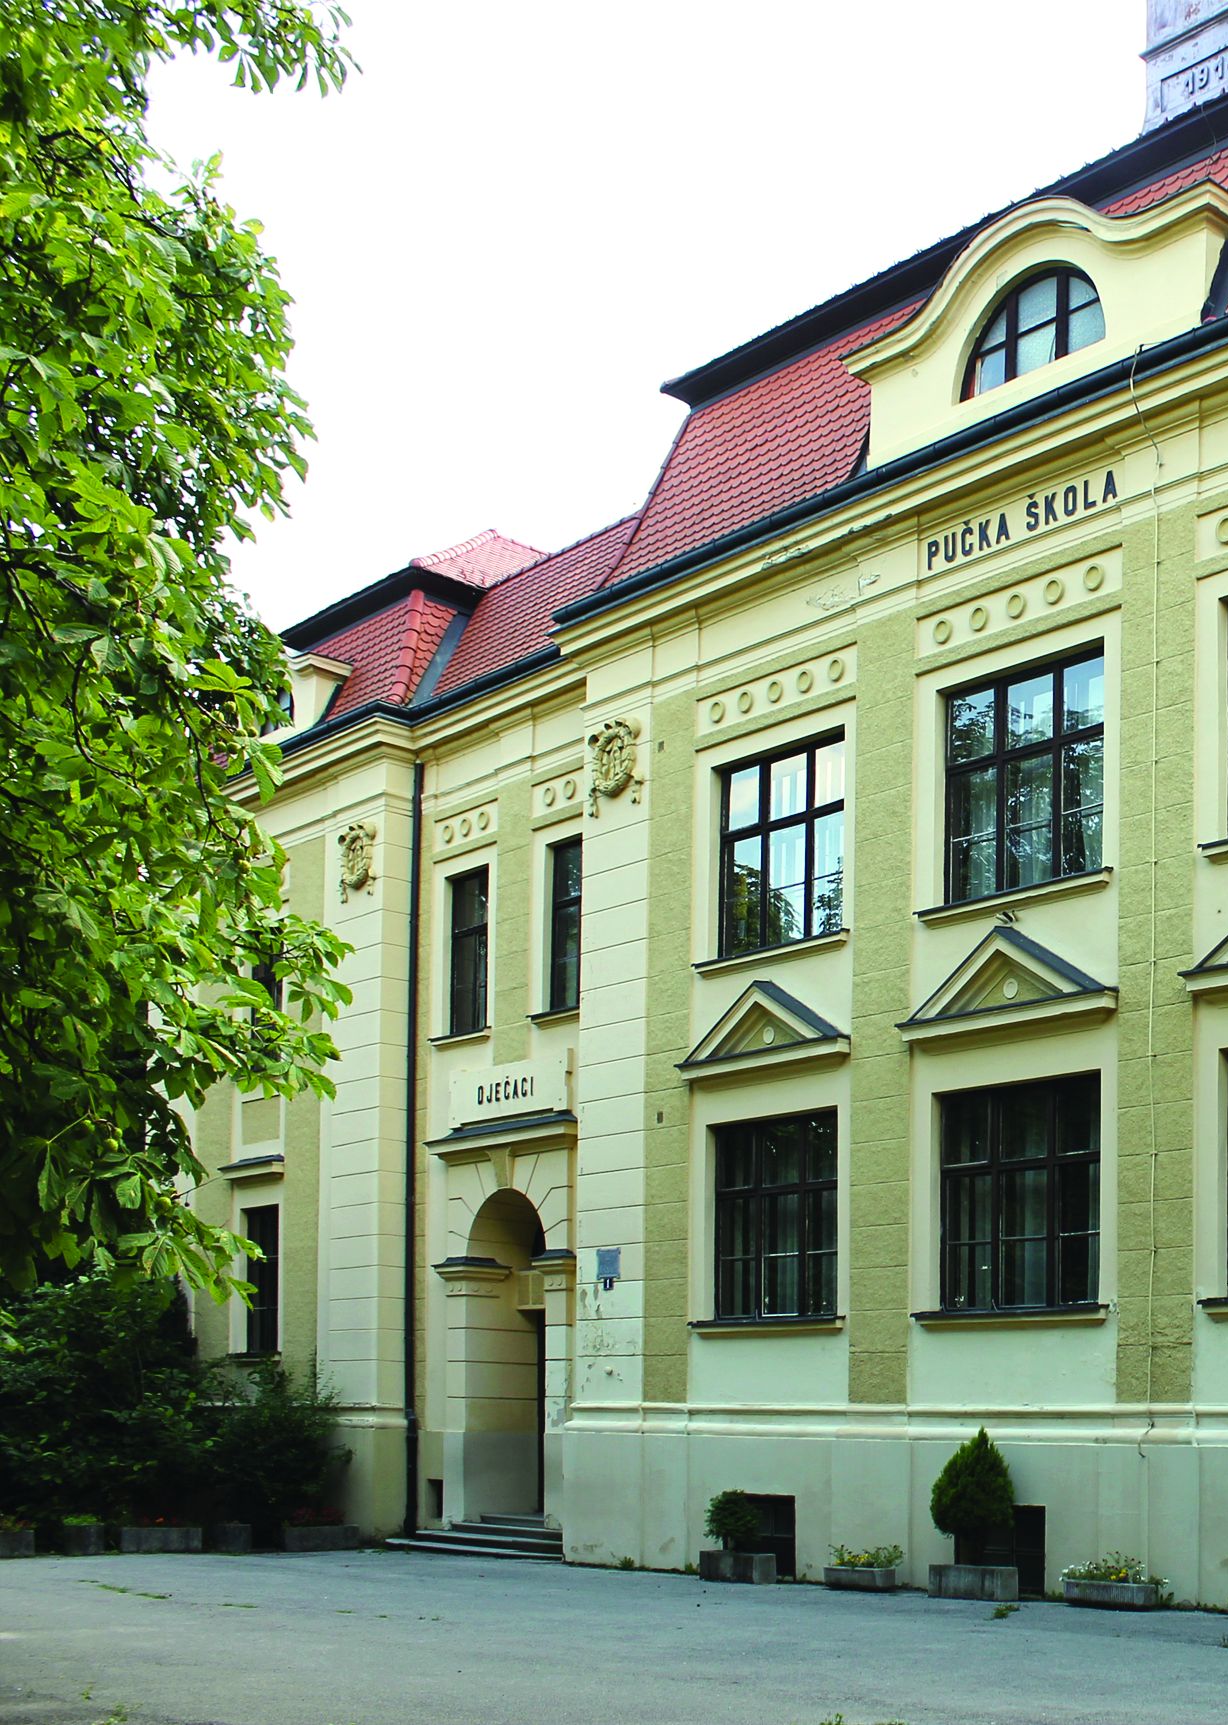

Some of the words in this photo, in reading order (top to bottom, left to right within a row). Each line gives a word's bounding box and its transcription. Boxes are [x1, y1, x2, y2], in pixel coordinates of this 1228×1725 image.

[927, 519, 1011, 571] PUČKA
[1026, 470, 1118, 532] ŠKOLA
[477, 1076, 534, 1106] DJEČACI
